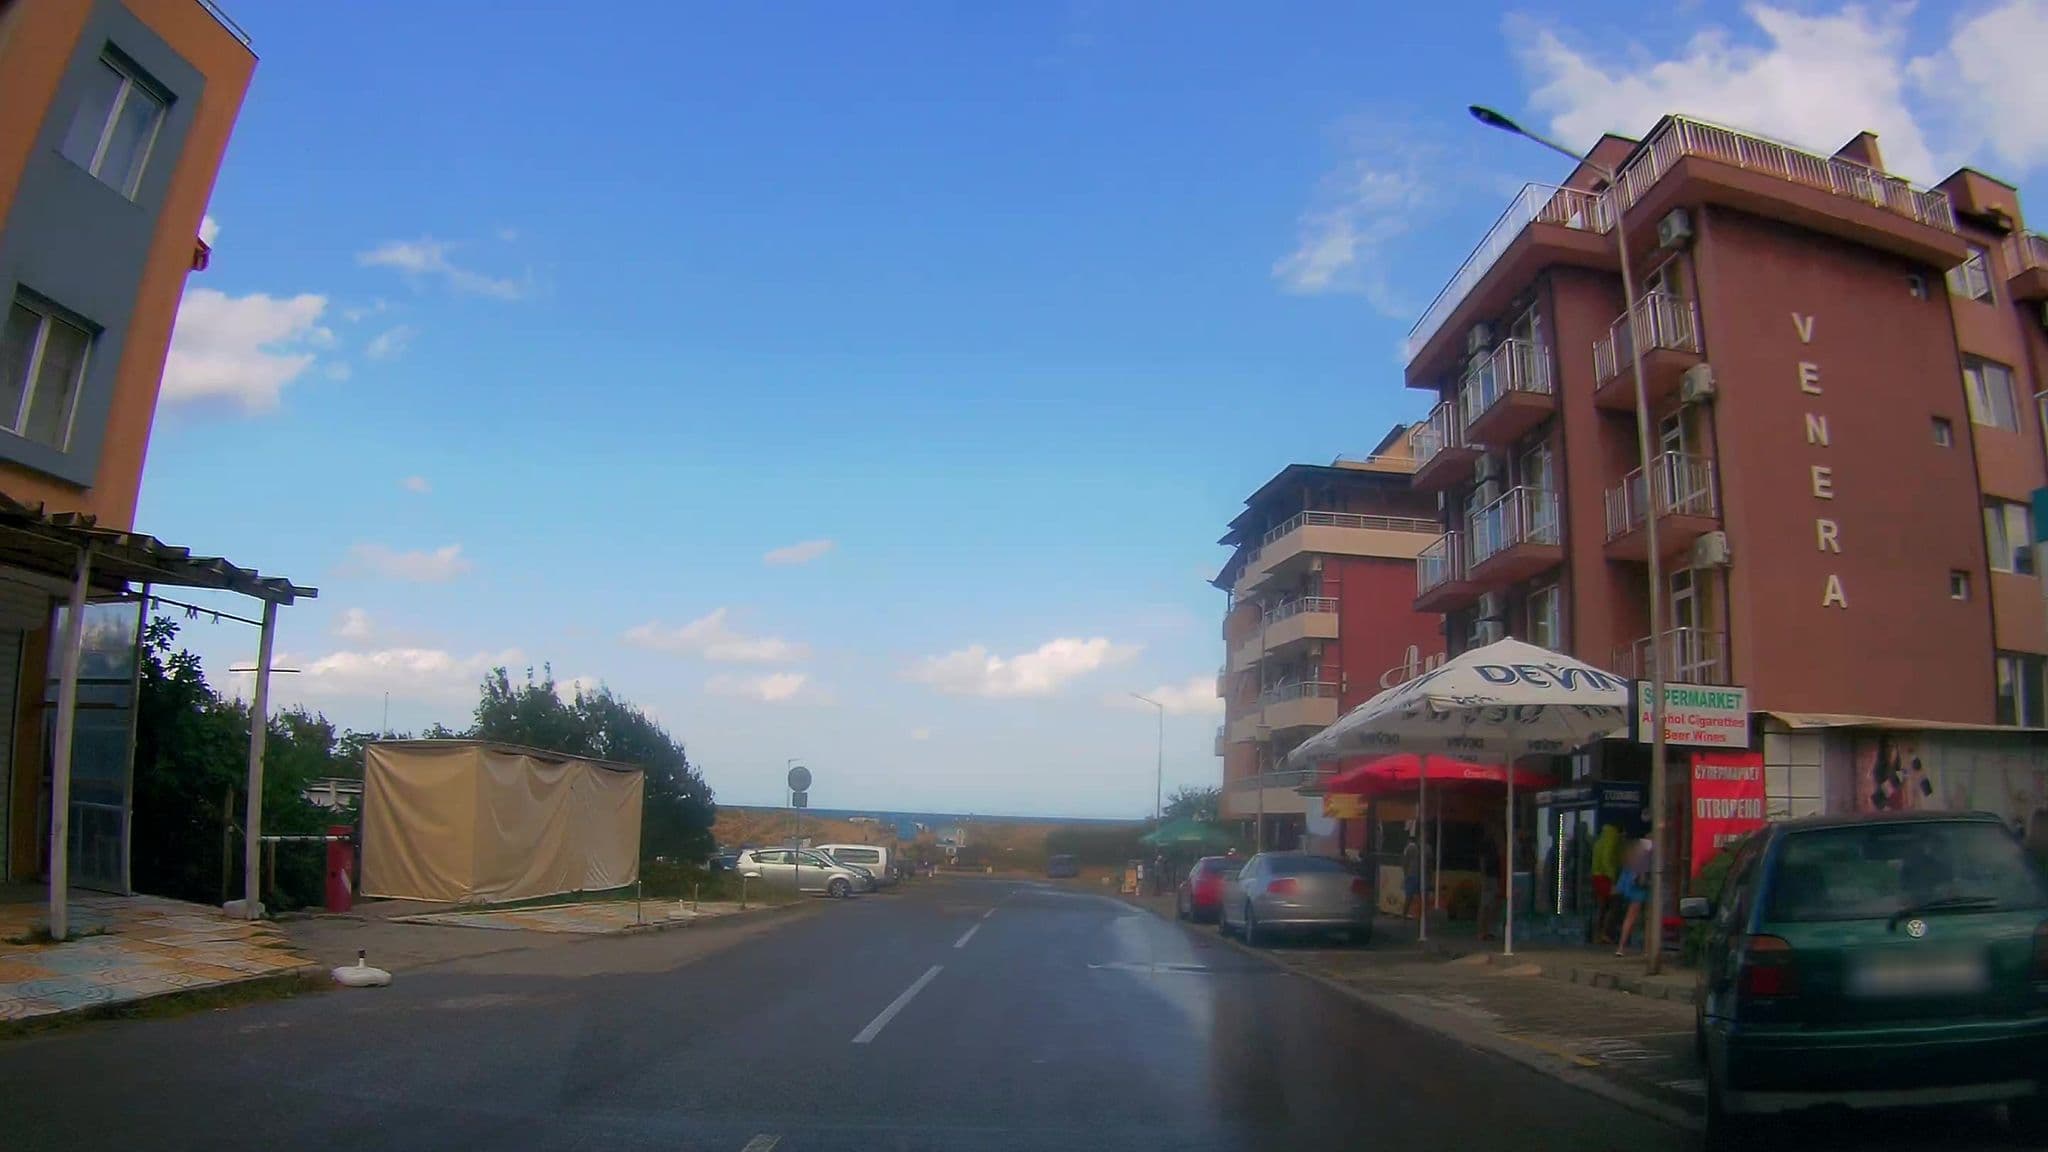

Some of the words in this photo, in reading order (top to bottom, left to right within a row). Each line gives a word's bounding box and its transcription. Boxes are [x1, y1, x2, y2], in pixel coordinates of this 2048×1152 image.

[1792, 312, 1848, 609] VENERA
[1644, 688, 1742, 709] SPERMARKET
[1642, 711, 1685, 725] Alhol
[1688, 714, 1745, 728] Cigarettes
[1697, 798, 1760, 819] ОТВОРЕНО
